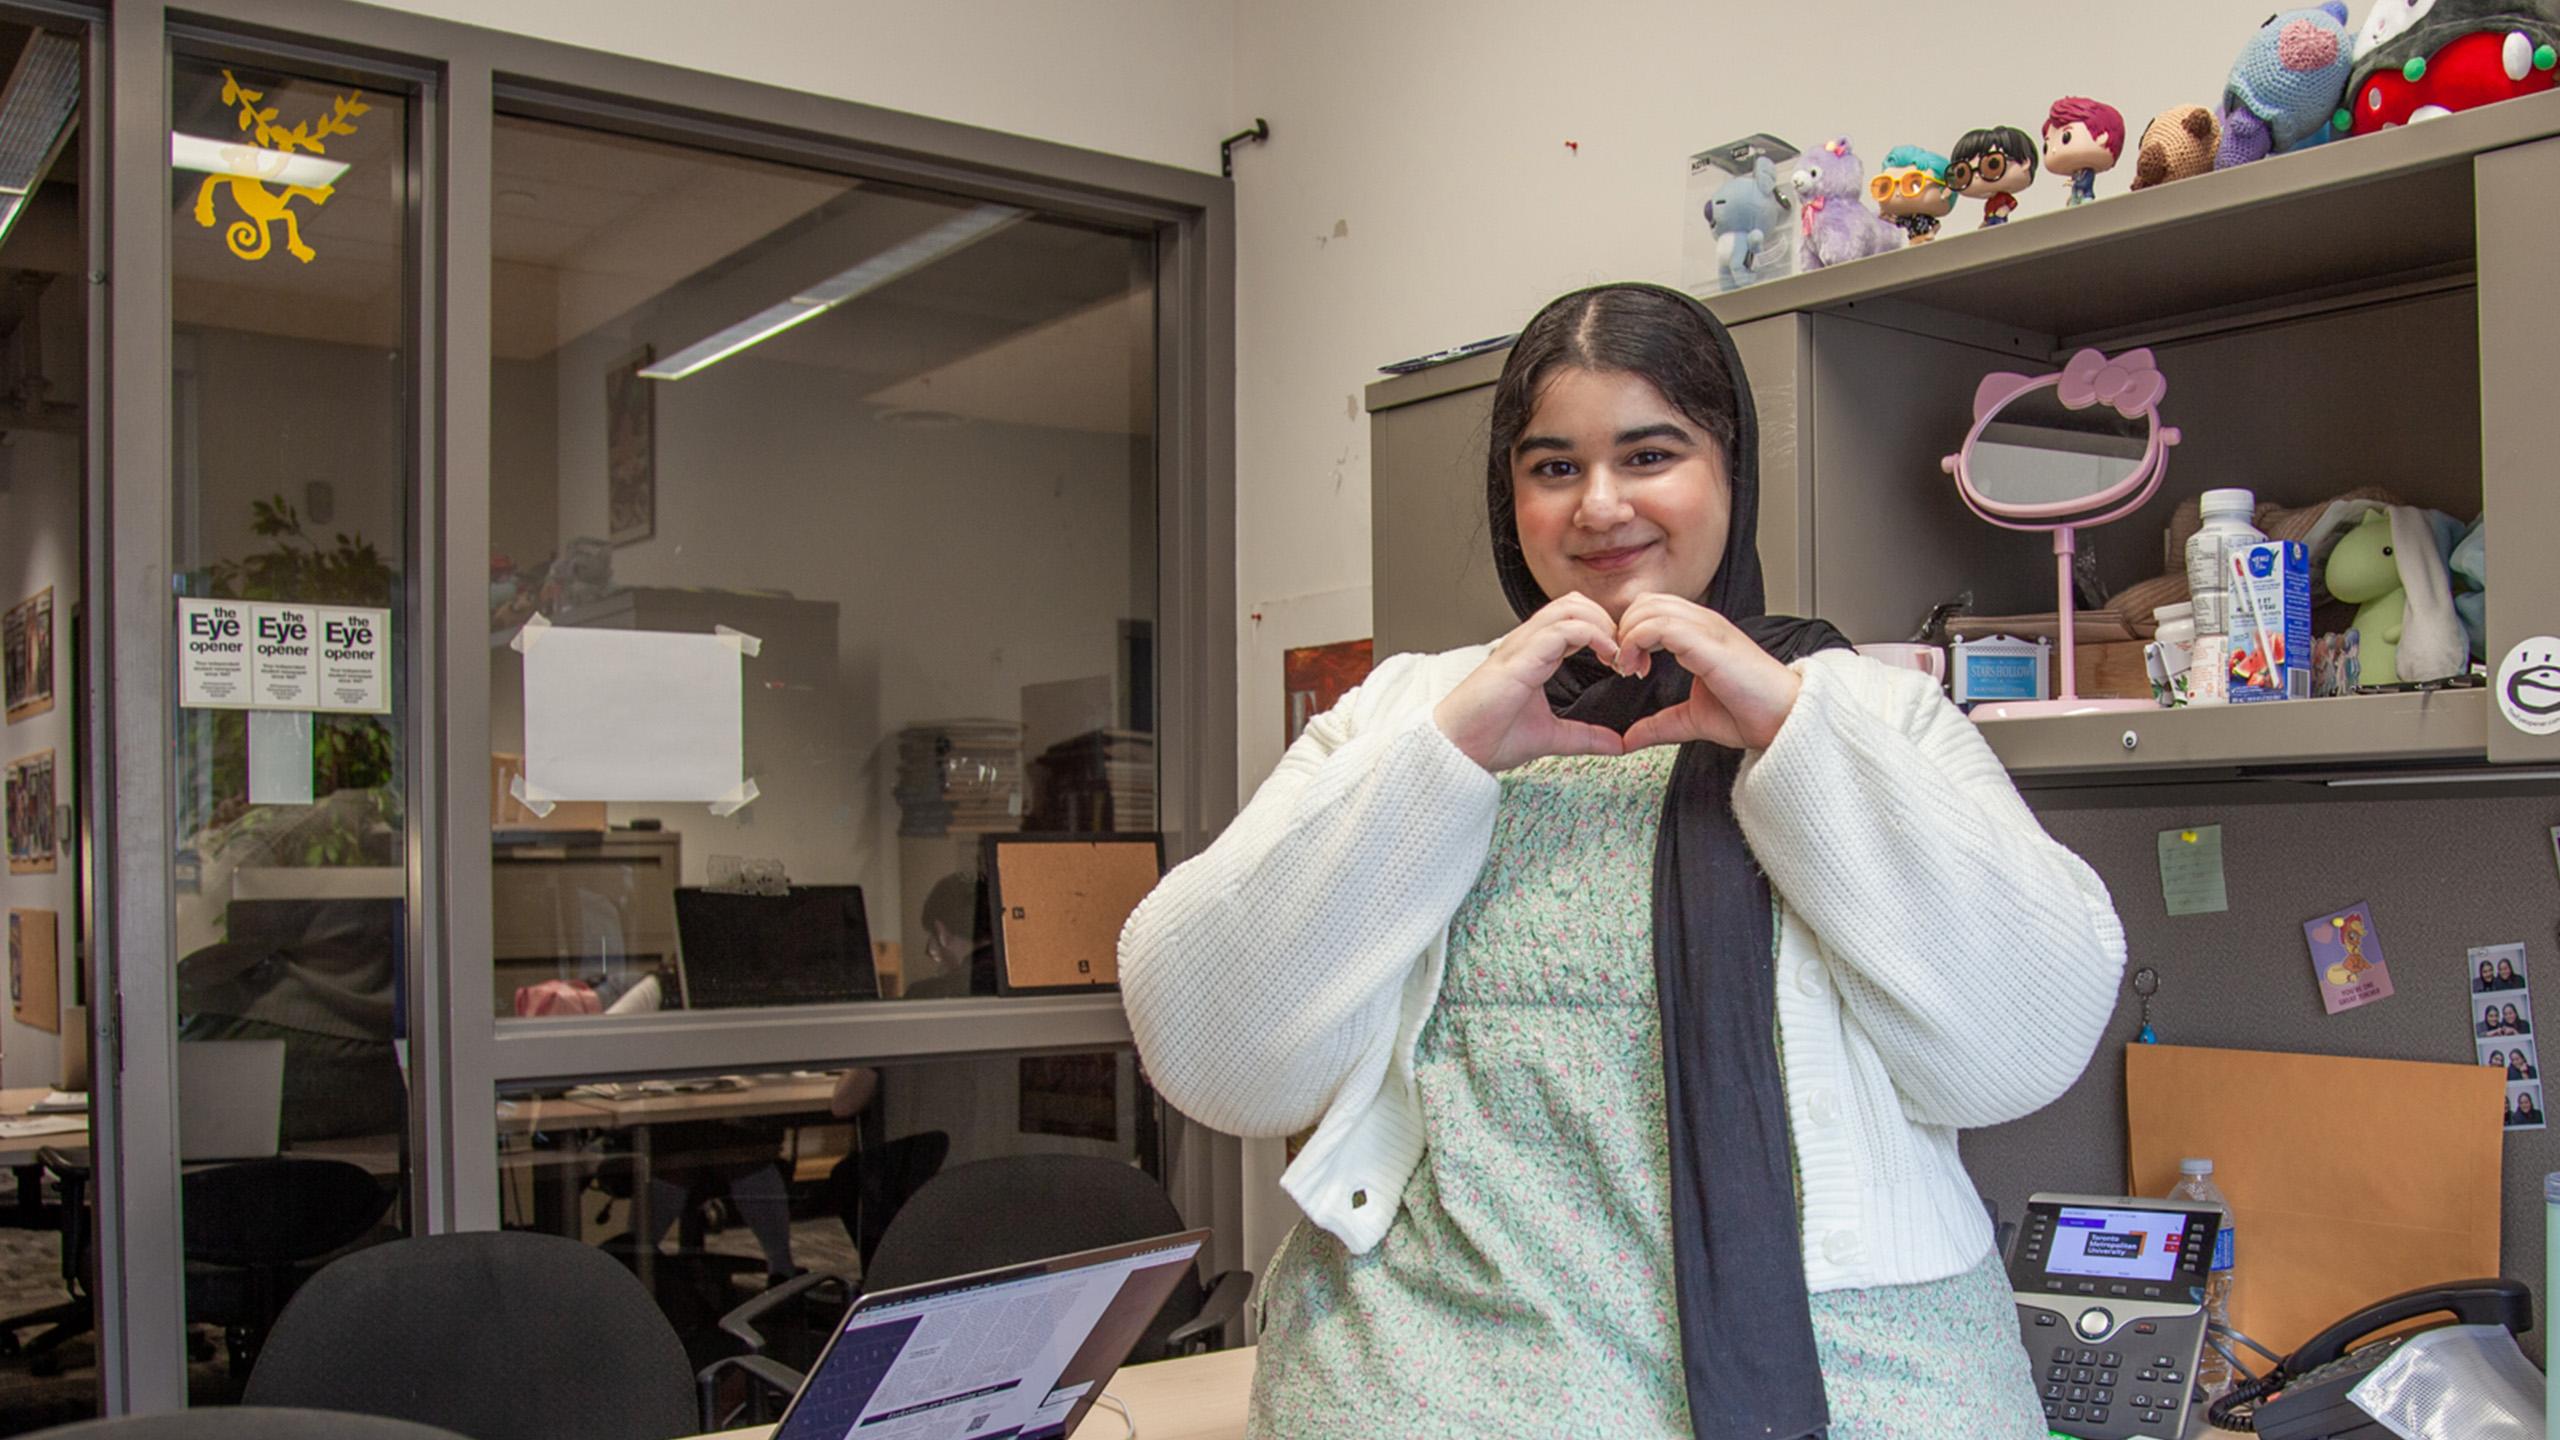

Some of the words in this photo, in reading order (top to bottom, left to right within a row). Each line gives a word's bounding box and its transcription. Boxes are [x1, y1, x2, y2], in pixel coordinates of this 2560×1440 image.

[214, 607, 236, 618] the
[282, 611, 304, 623] the
[190, 613, 240, 641] Eye
[348, 616, 370, 627] the
[258, 616, 307, 644] Eye
[325, 622, 373, 648] Eye
[190, 641, 243, 654] opener
[257, 644, 309, 657] opener
[324, 649, 375, 661] opener
[2091, 1233, 2120, 1242] Toronto
[2089, 1240, 2137, 1250] Metropolitan
[2087, 1247, 2127, 1256] University
